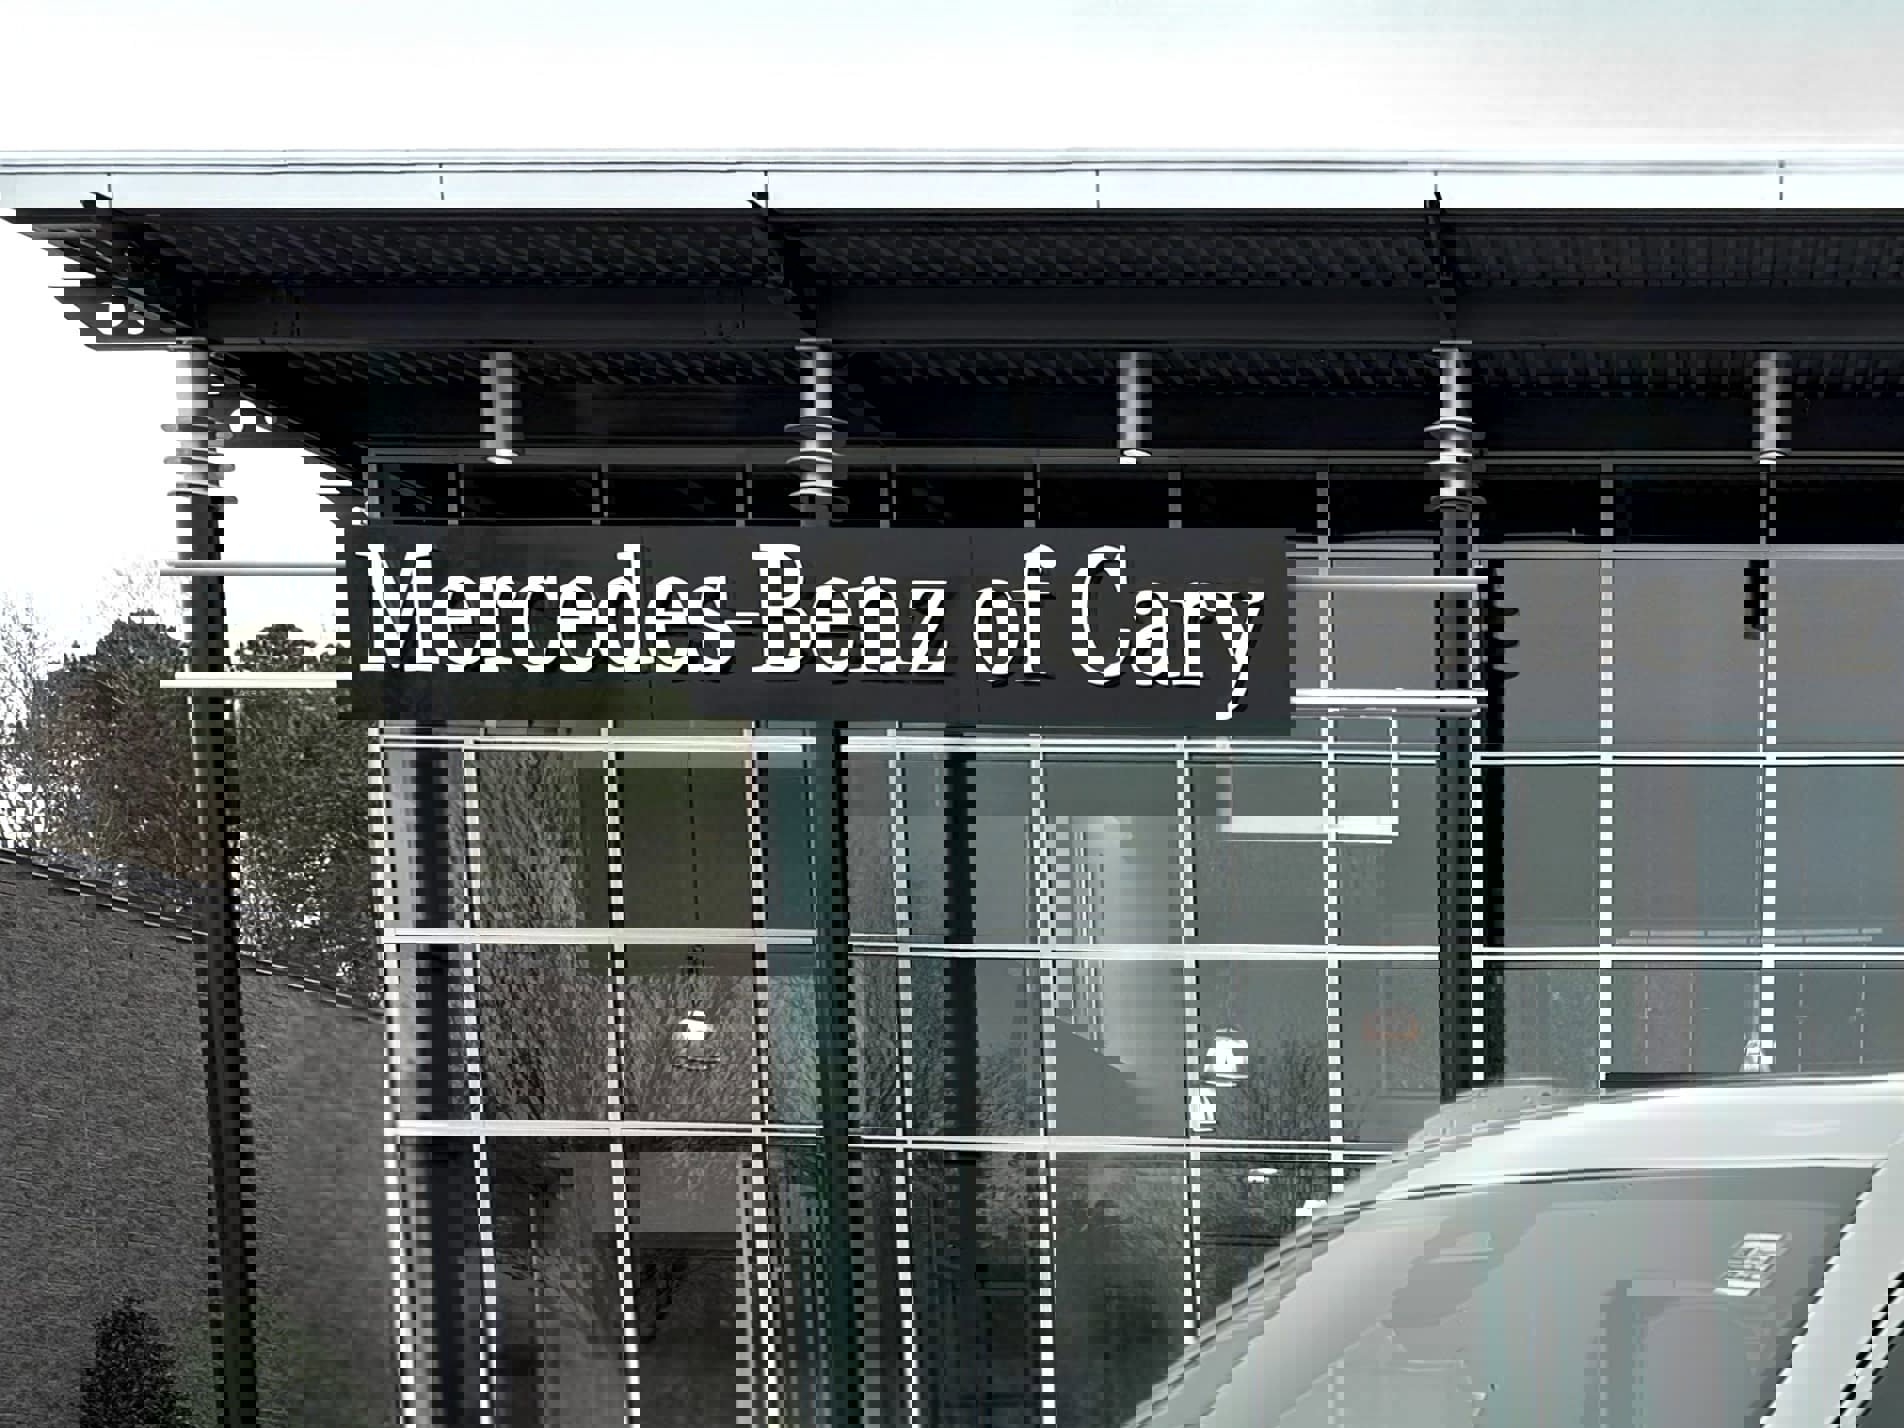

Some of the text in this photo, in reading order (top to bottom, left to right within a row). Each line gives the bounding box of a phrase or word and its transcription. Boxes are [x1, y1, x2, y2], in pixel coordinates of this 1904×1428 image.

[354, 543, 1265, 721] Mercedes-Benz of Cary
